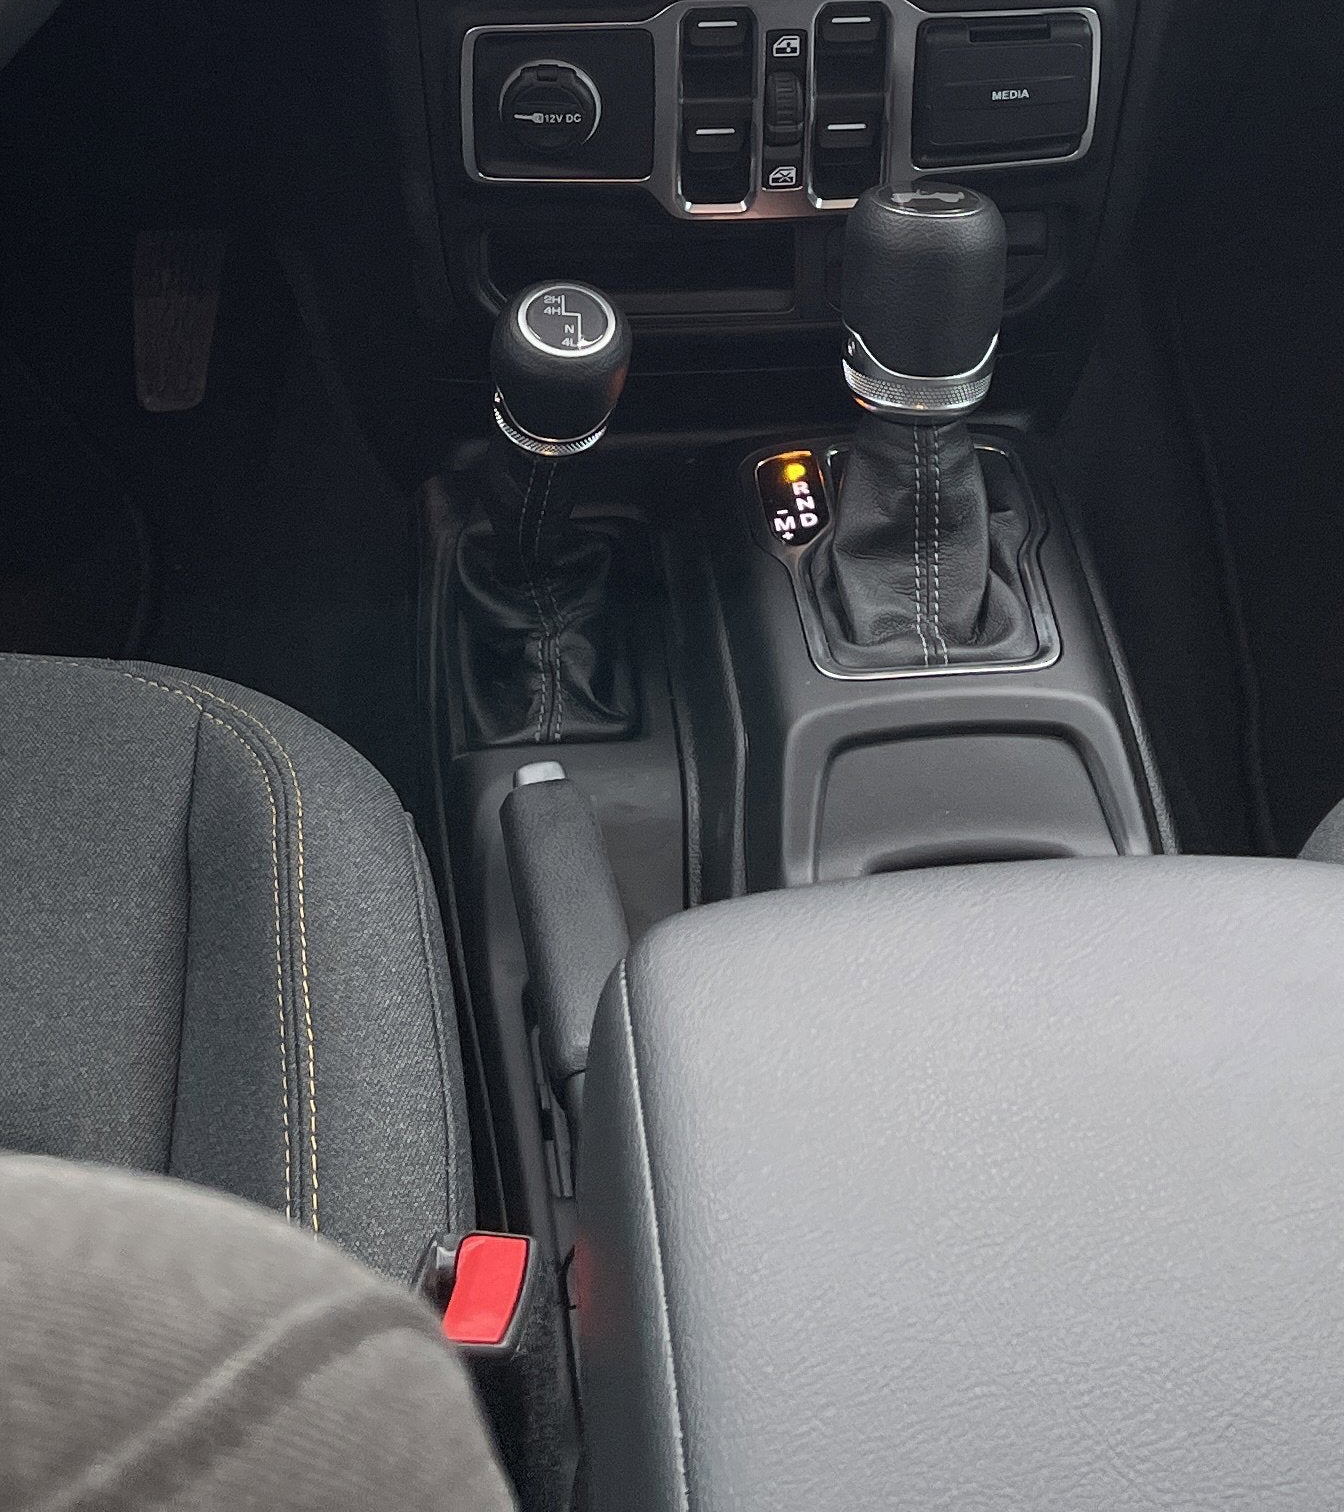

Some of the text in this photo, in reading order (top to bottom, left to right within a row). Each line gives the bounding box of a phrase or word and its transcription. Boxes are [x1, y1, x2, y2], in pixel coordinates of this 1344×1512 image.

[991, 89, 1030, 101] MEDIA
[544, 112, 582, 123] 12V DC
[543, 294, 561, 304] 2H
[543, 306, 561, 316] 4H
[564, 324, 574, 334] N
[792, 481, 810, 496] R
[795, 495, 816, 511] N
[774, 515, 797, 532] M
[799, 512, 819, 528] D
